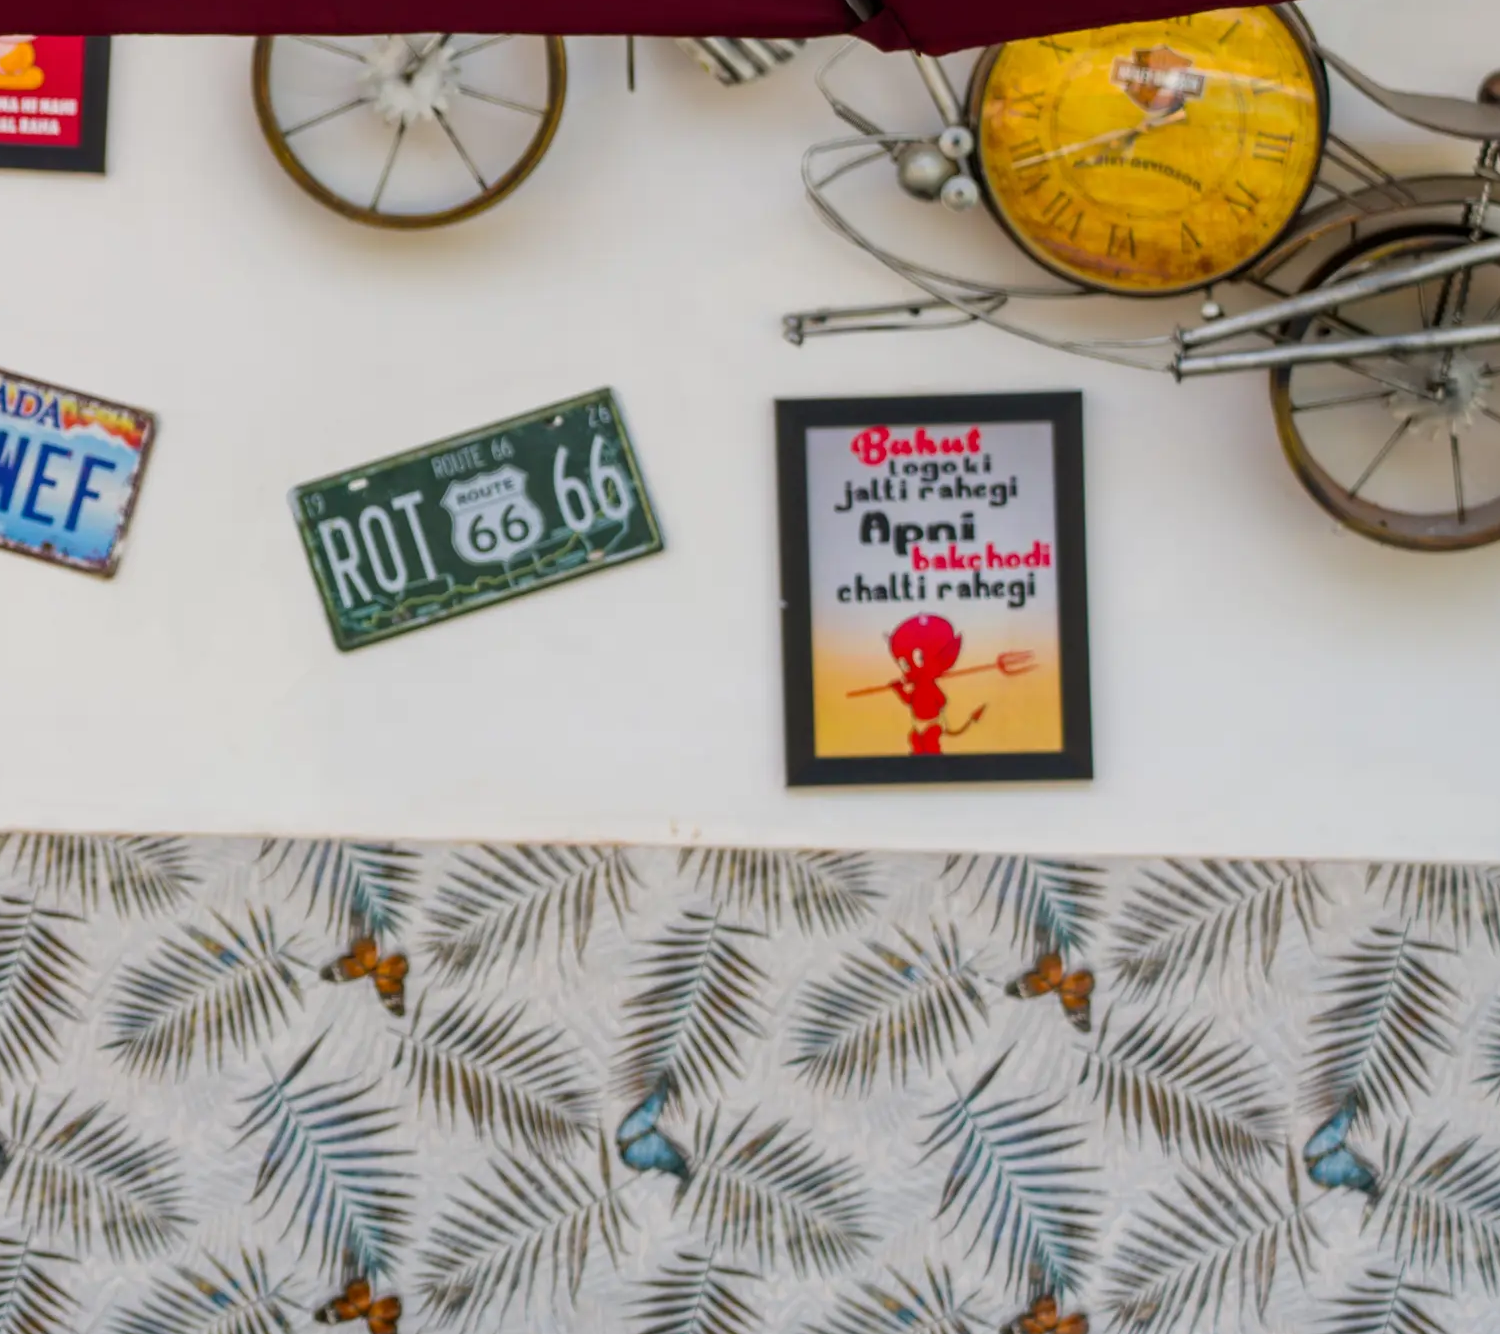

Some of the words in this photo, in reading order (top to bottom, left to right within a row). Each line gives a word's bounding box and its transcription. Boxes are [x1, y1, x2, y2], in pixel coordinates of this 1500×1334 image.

[431, 442, 486, 480] ROUTE
[490, 436, 515, 466] 66
[851, 424, 982, 466] Bahut
[456, 477, 515, 507] ROUTE
[553, 433, 632, 534] 66
[835, 481, 907, 513] jalti
[918, 475, 1019, 507] rahegi
[303, 494, 326, 517] 19
[318, 489, 437, 609] ROT
[467, 503, 531, 553] 66
[859, 510, 976, 555] Apni
[910, 539, 1052, 572] bakchodi
[837, 574, 926, 603] chalti
[937, 571, 1036, 609] rahegi
